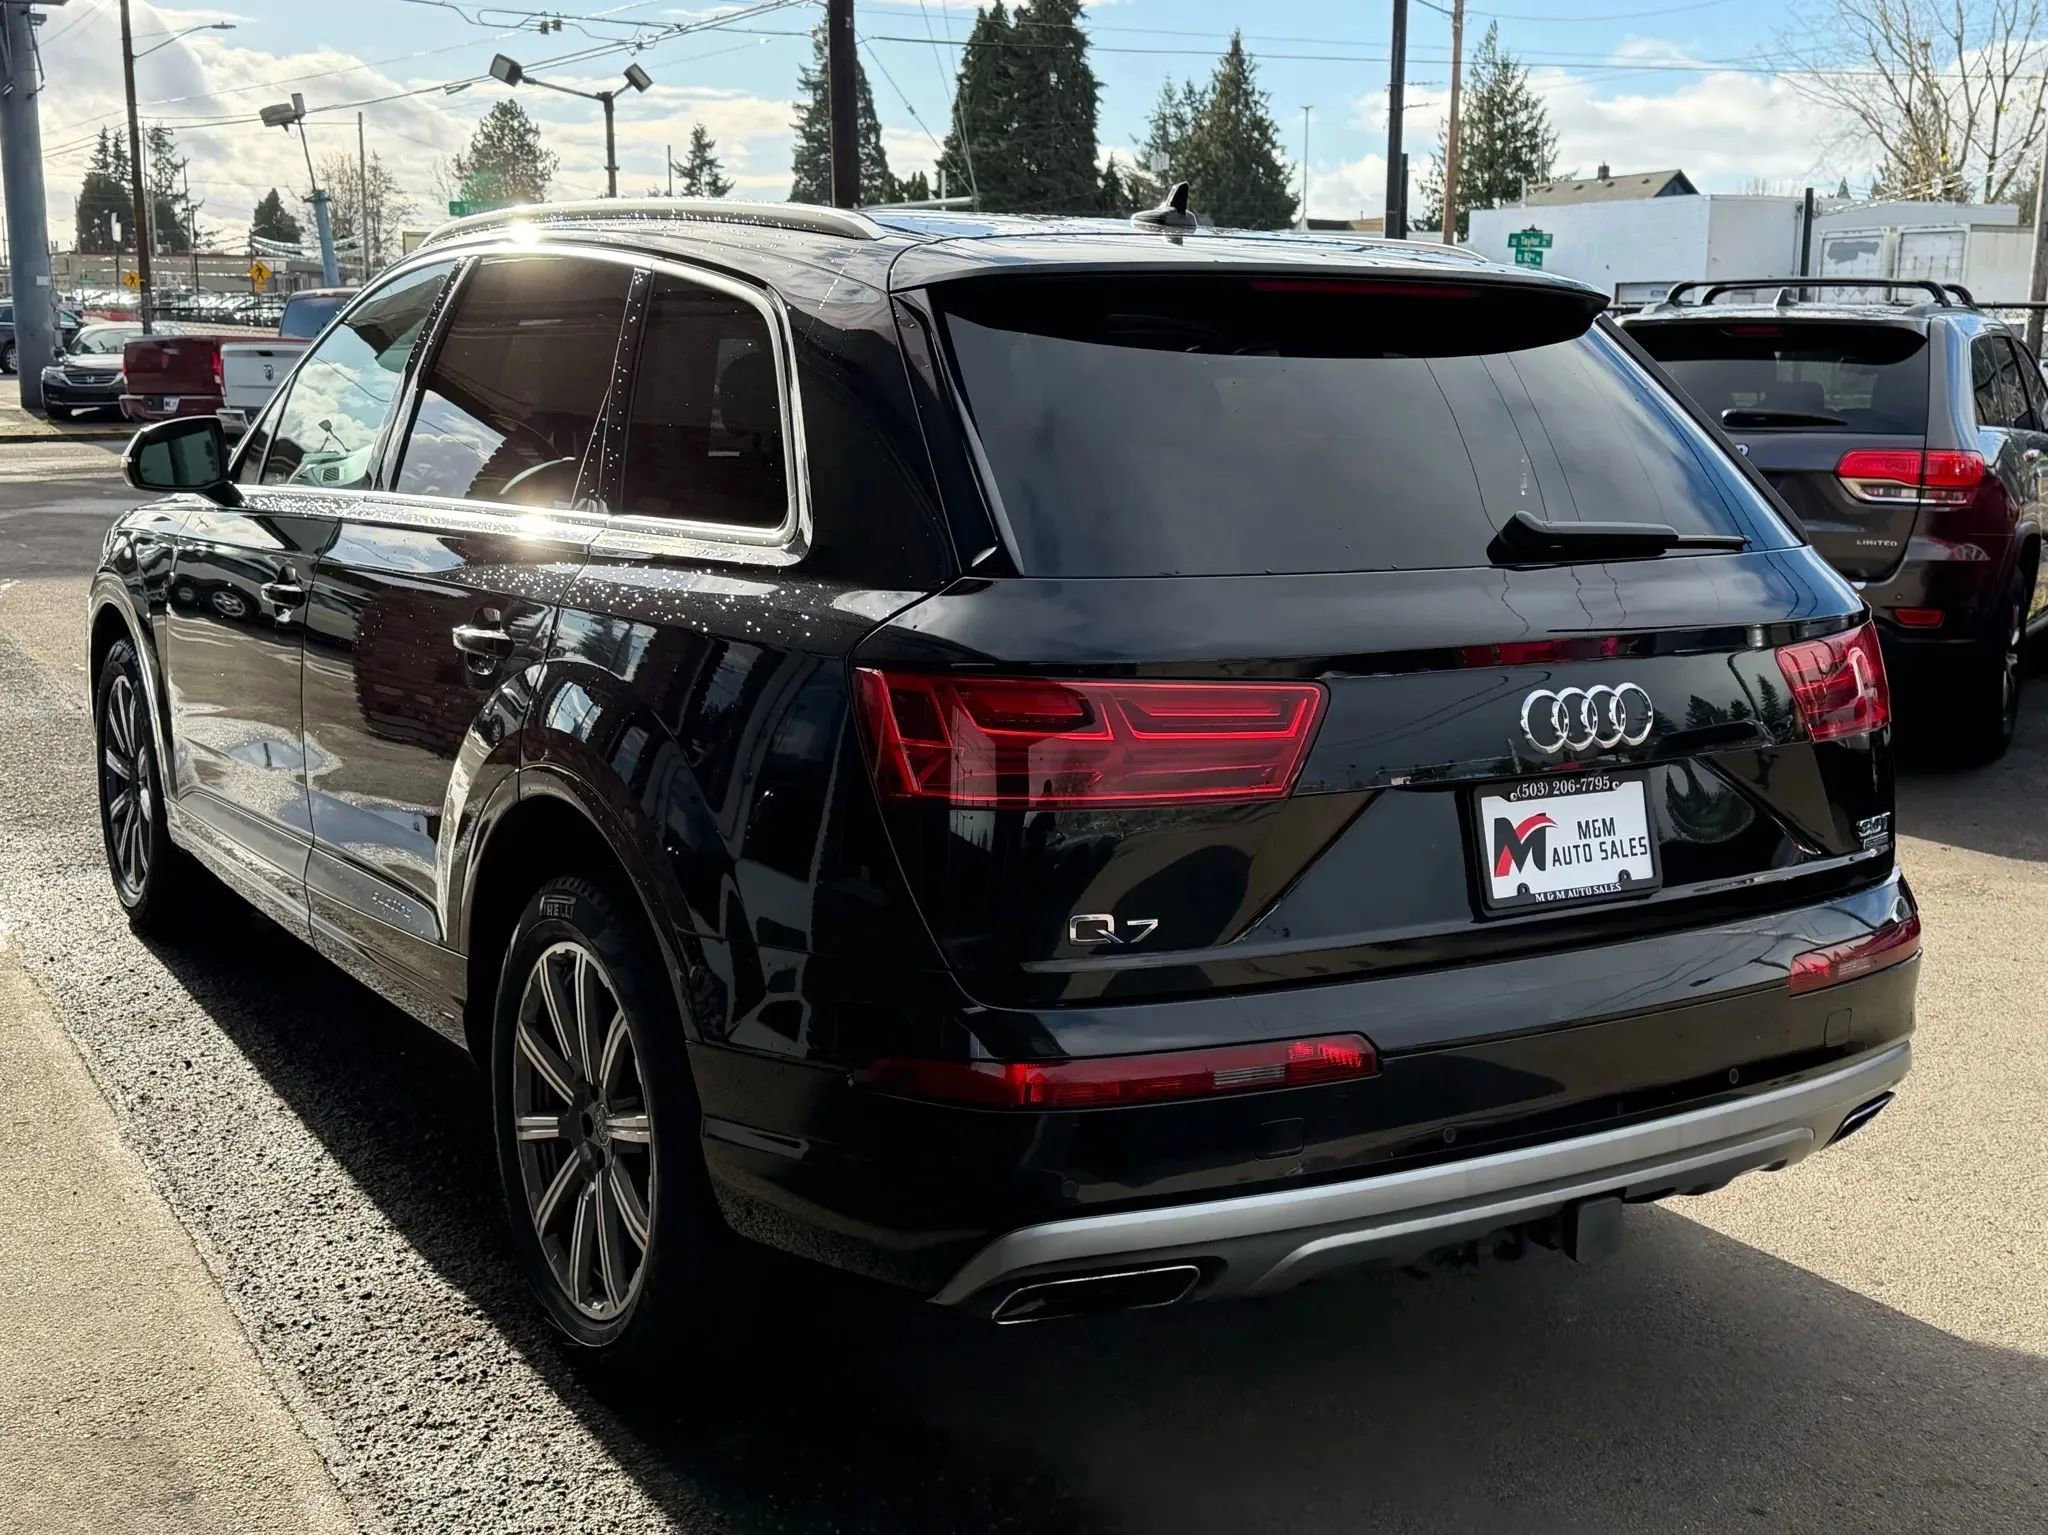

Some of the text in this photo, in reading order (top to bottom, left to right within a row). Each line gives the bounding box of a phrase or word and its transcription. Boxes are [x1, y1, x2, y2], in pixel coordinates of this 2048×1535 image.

[1521, 236, 1540, 249] Taylor
[1856, 539, 1898, 547] LIMITED
[1516, 776, 1610, 798] (503) 206-7795
[1577, 817, 1616, 840] M&M
[1552, 836, 1648, 867] AUTO SALES
[1535, 893, 1545, 903] M
[1556, 890, 1567, 900] M
[1568, 887, 1593, 899] AUTO
[1594, 882, 1622, 894] SALES
[539, 895, 577, 919] PIRELLI
[1069, 913, 1159, 945] Q7
